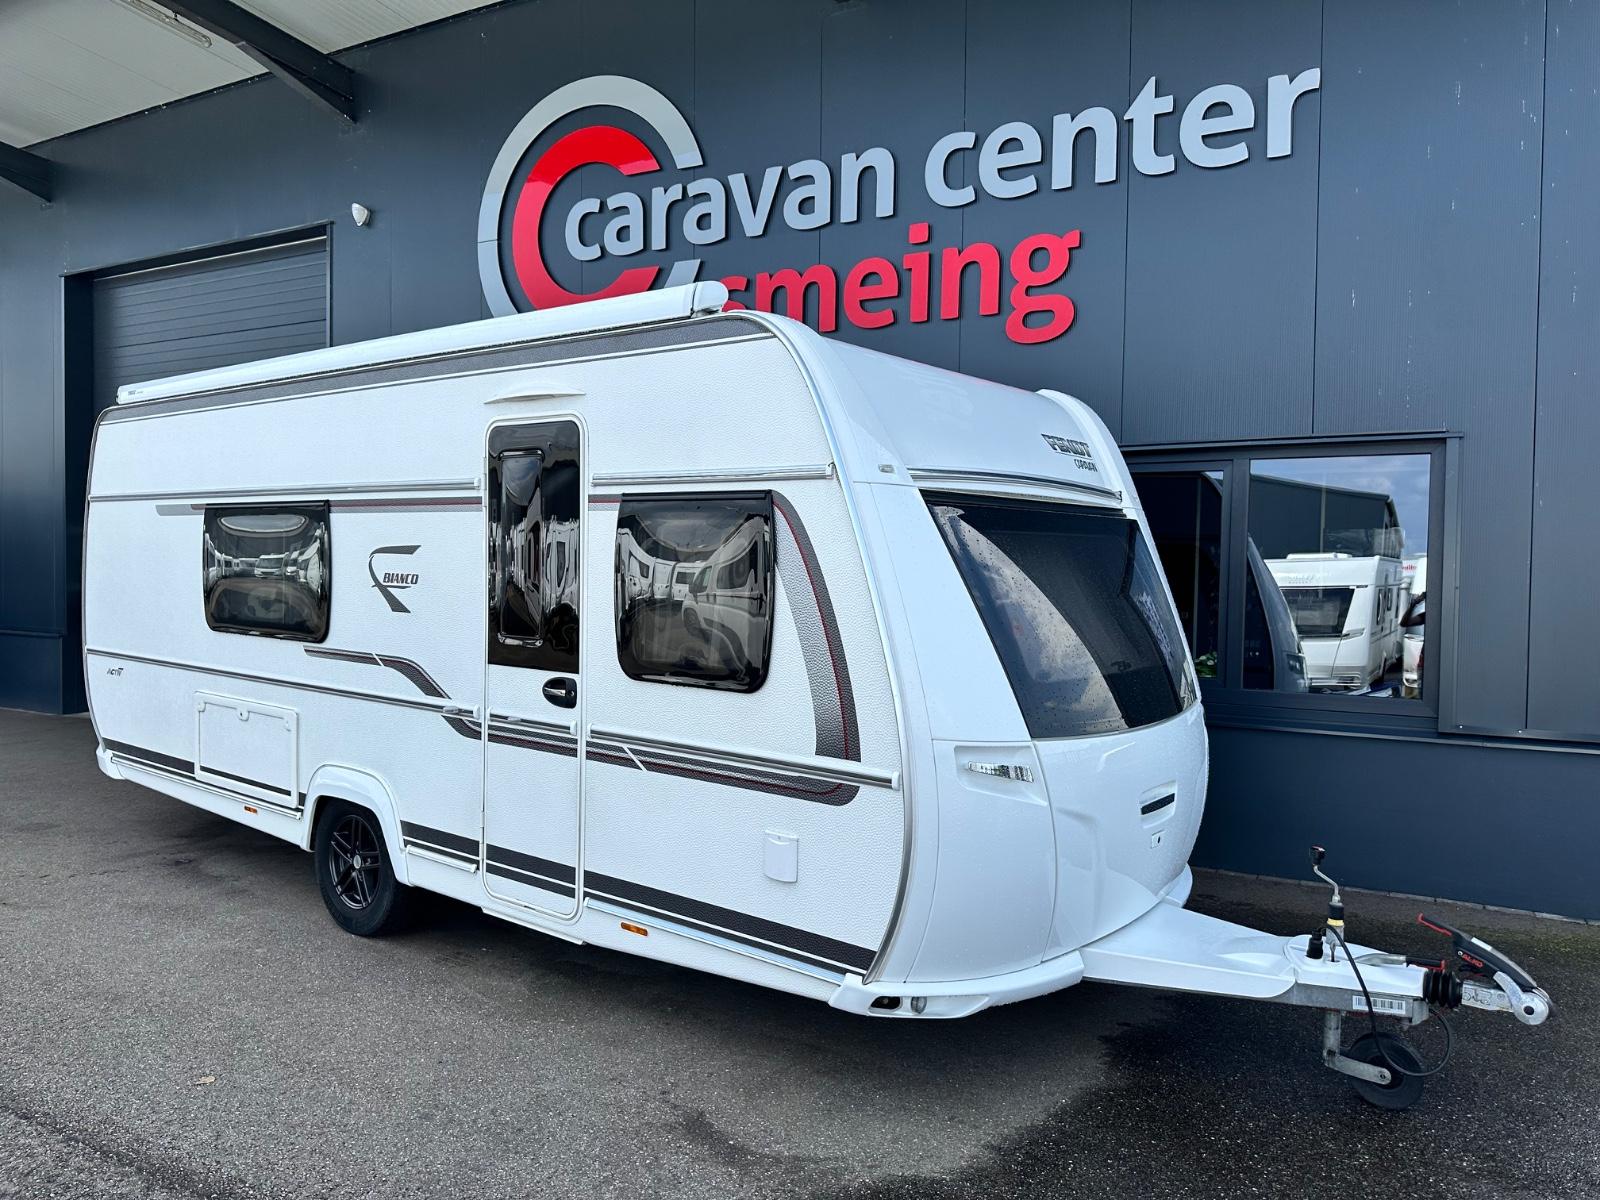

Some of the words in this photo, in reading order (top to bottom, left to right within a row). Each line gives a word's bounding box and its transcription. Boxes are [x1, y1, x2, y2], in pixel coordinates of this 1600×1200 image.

[565, 147, 895, 261] caravan
[924, 67, 1321, 208] center
[383, 572, 419, 585] BIANCO
